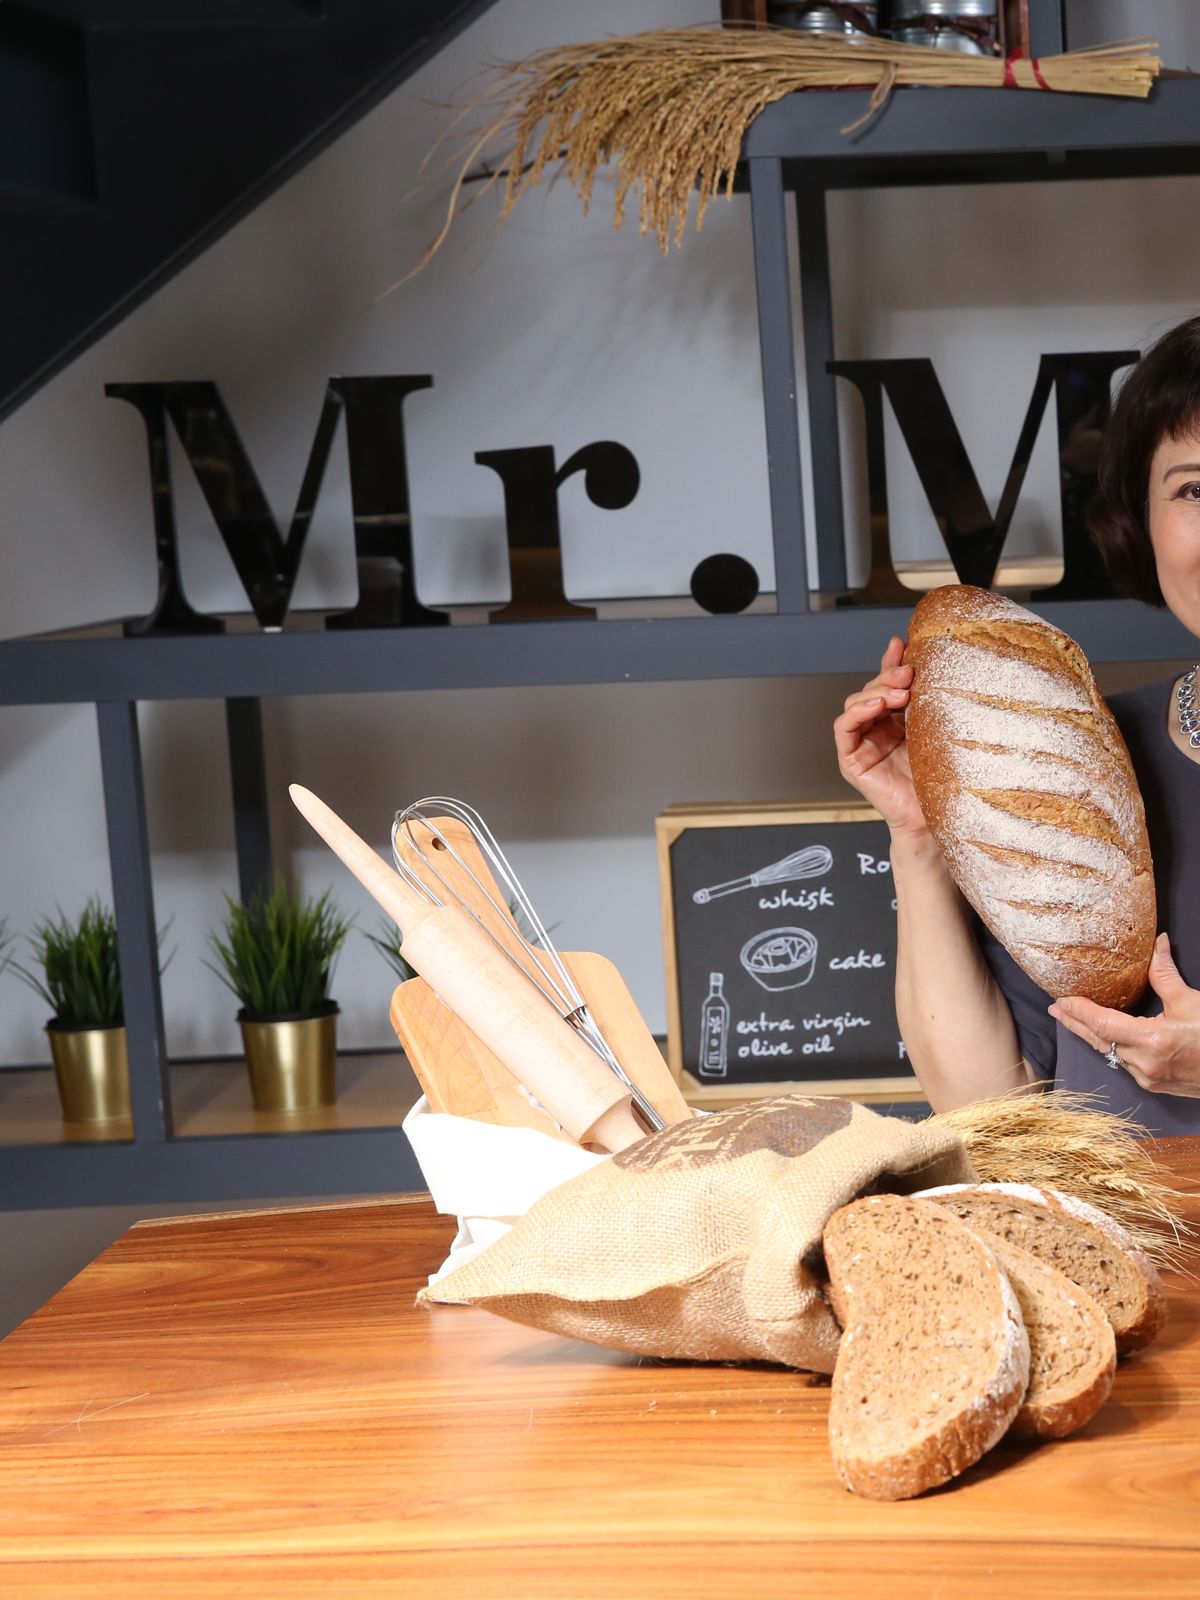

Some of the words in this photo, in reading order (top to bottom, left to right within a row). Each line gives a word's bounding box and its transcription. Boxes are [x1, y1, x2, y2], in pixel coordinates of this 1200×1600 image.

[105, 374, 760, 638] Mr.
[758, 887, 835, 911] whisk
[829, 949, 886, 971] cake
[736, 1013, 795, 1034] extra
[802, 1012, 871, 1035] virgin
[738, 1038, 793, 1058] olive
[802, 1034, 835, 1054] oil
